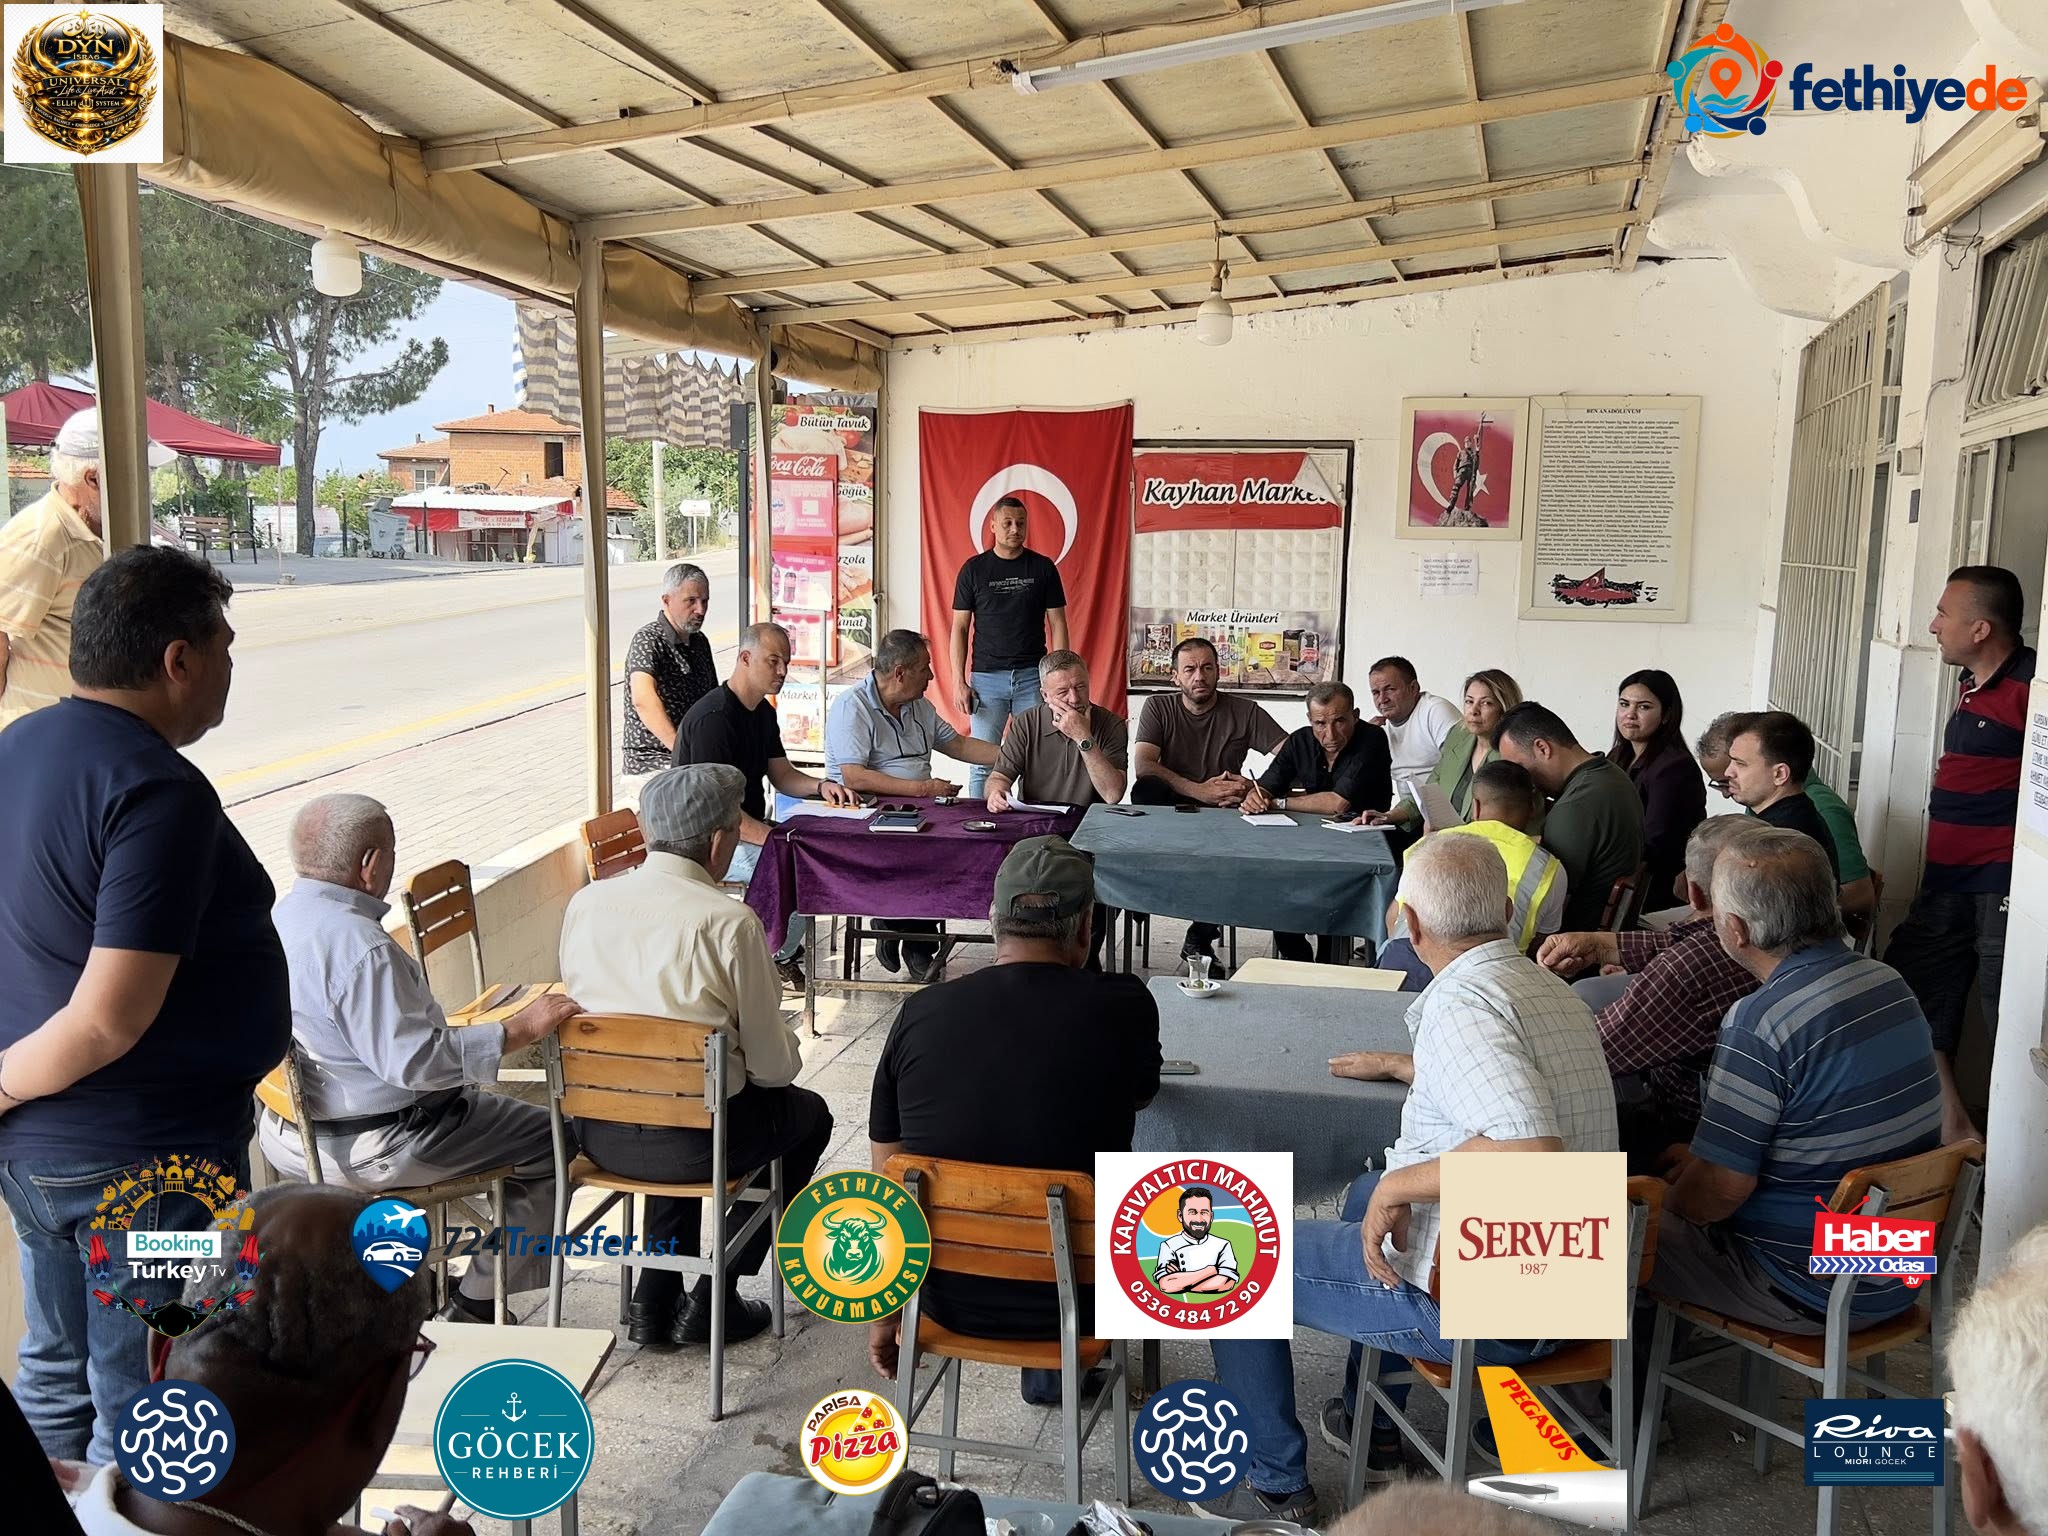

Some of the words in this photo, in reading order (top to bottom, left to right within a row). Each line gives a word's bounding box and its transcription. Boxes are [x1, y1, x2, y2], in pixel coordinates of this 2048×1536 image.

[800, 415, 833, 428] Bütün
[836, 416, 869, 429] Tavuk
[1144, 480, 1235, 508] Kayhan
[1241, 480, 1327, 503] Marke
[1187, 611, 1227, 623] Market
